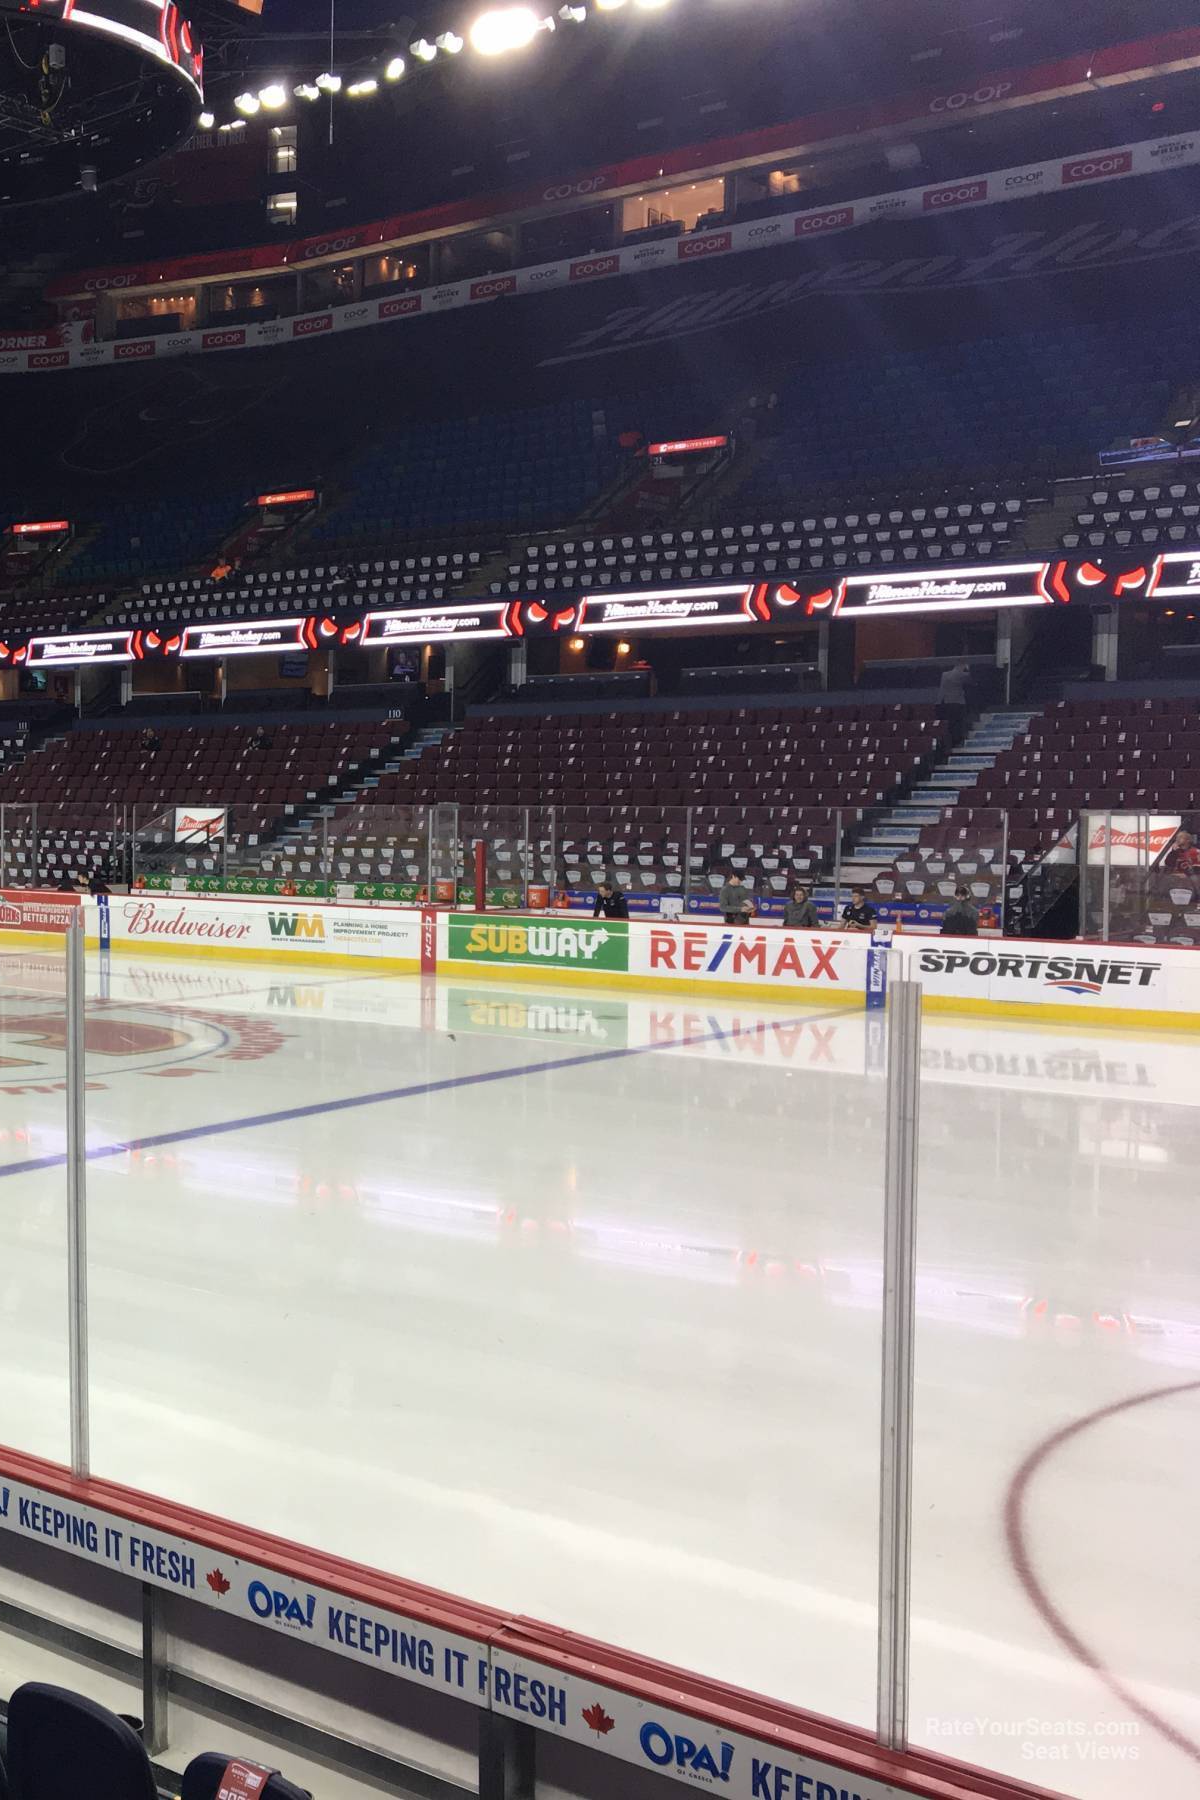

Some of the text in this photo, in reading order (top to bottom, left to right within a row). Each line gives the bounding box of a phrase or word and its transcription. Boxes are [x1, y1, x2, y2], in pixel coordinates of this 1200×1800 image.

[388, 709, 401, 718] 110
[22, 912, 48, 922] BETTER
[123, 902, 252, 939] Budweiser
[268, 912, 325, 938] WM
[333, 928, 376, 936] IMPROVEMENT
[425, 915, 434, 959] CCM
[466, 923, 610, 960] SUBWAY
[650, 930, 842, 981] RE/MAX
[918, 947, 1162, 987] SPORTSNET
[19, 1497, 98, 1553] KEEPING
[105, 1527, 123, 1561] IT
[130, 1536, 195, 1589] FRESH
[247, 1581, 567, 1726] OPA! KEEPING IT FRESH
[640, 1721, 735, 1782] OPA!
